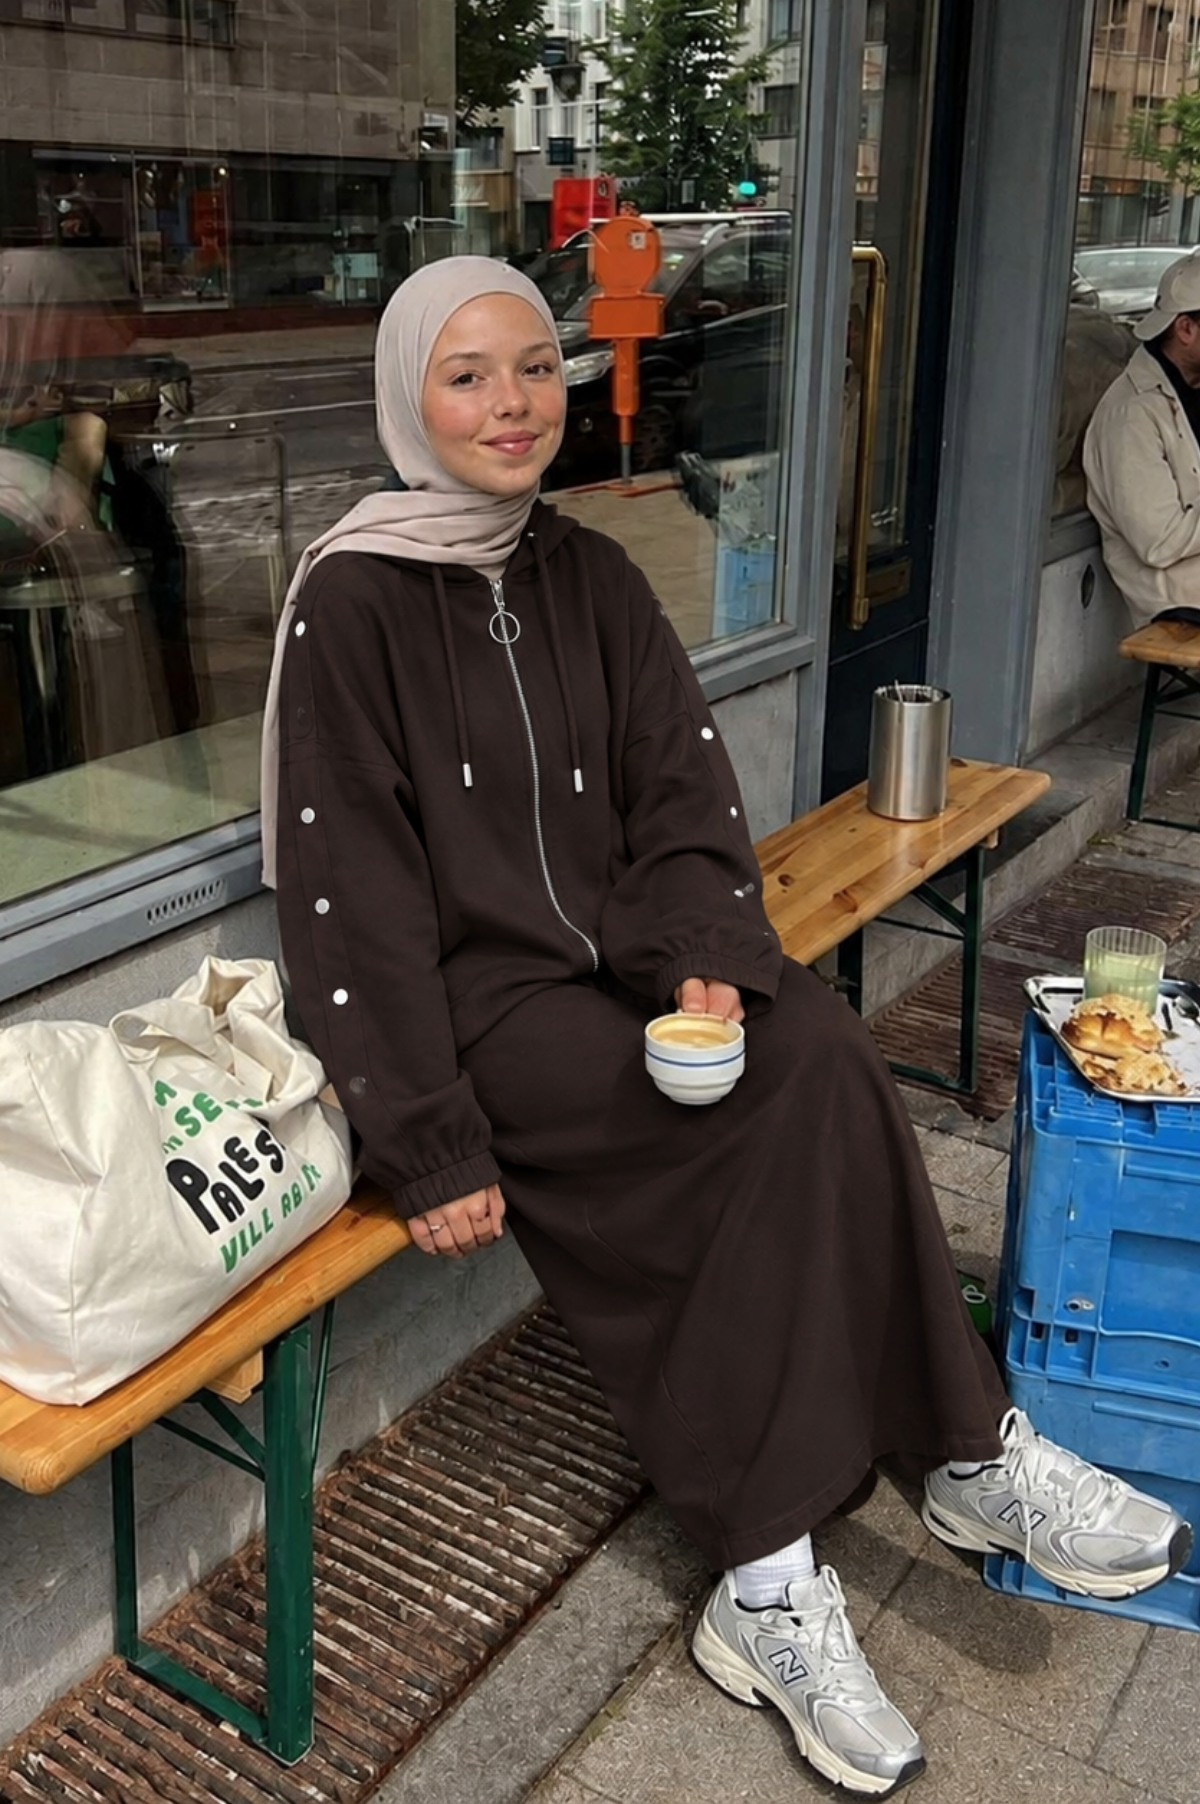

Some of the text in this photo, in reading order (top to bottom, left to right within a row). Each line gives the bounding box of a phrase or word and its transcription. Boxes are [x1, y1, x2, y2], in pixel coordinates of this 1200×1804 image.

[165, 1129, 286, 1234] PALES
[997, 1499, 1047, 1535] N
[768, 1646, 808, 1685] N
